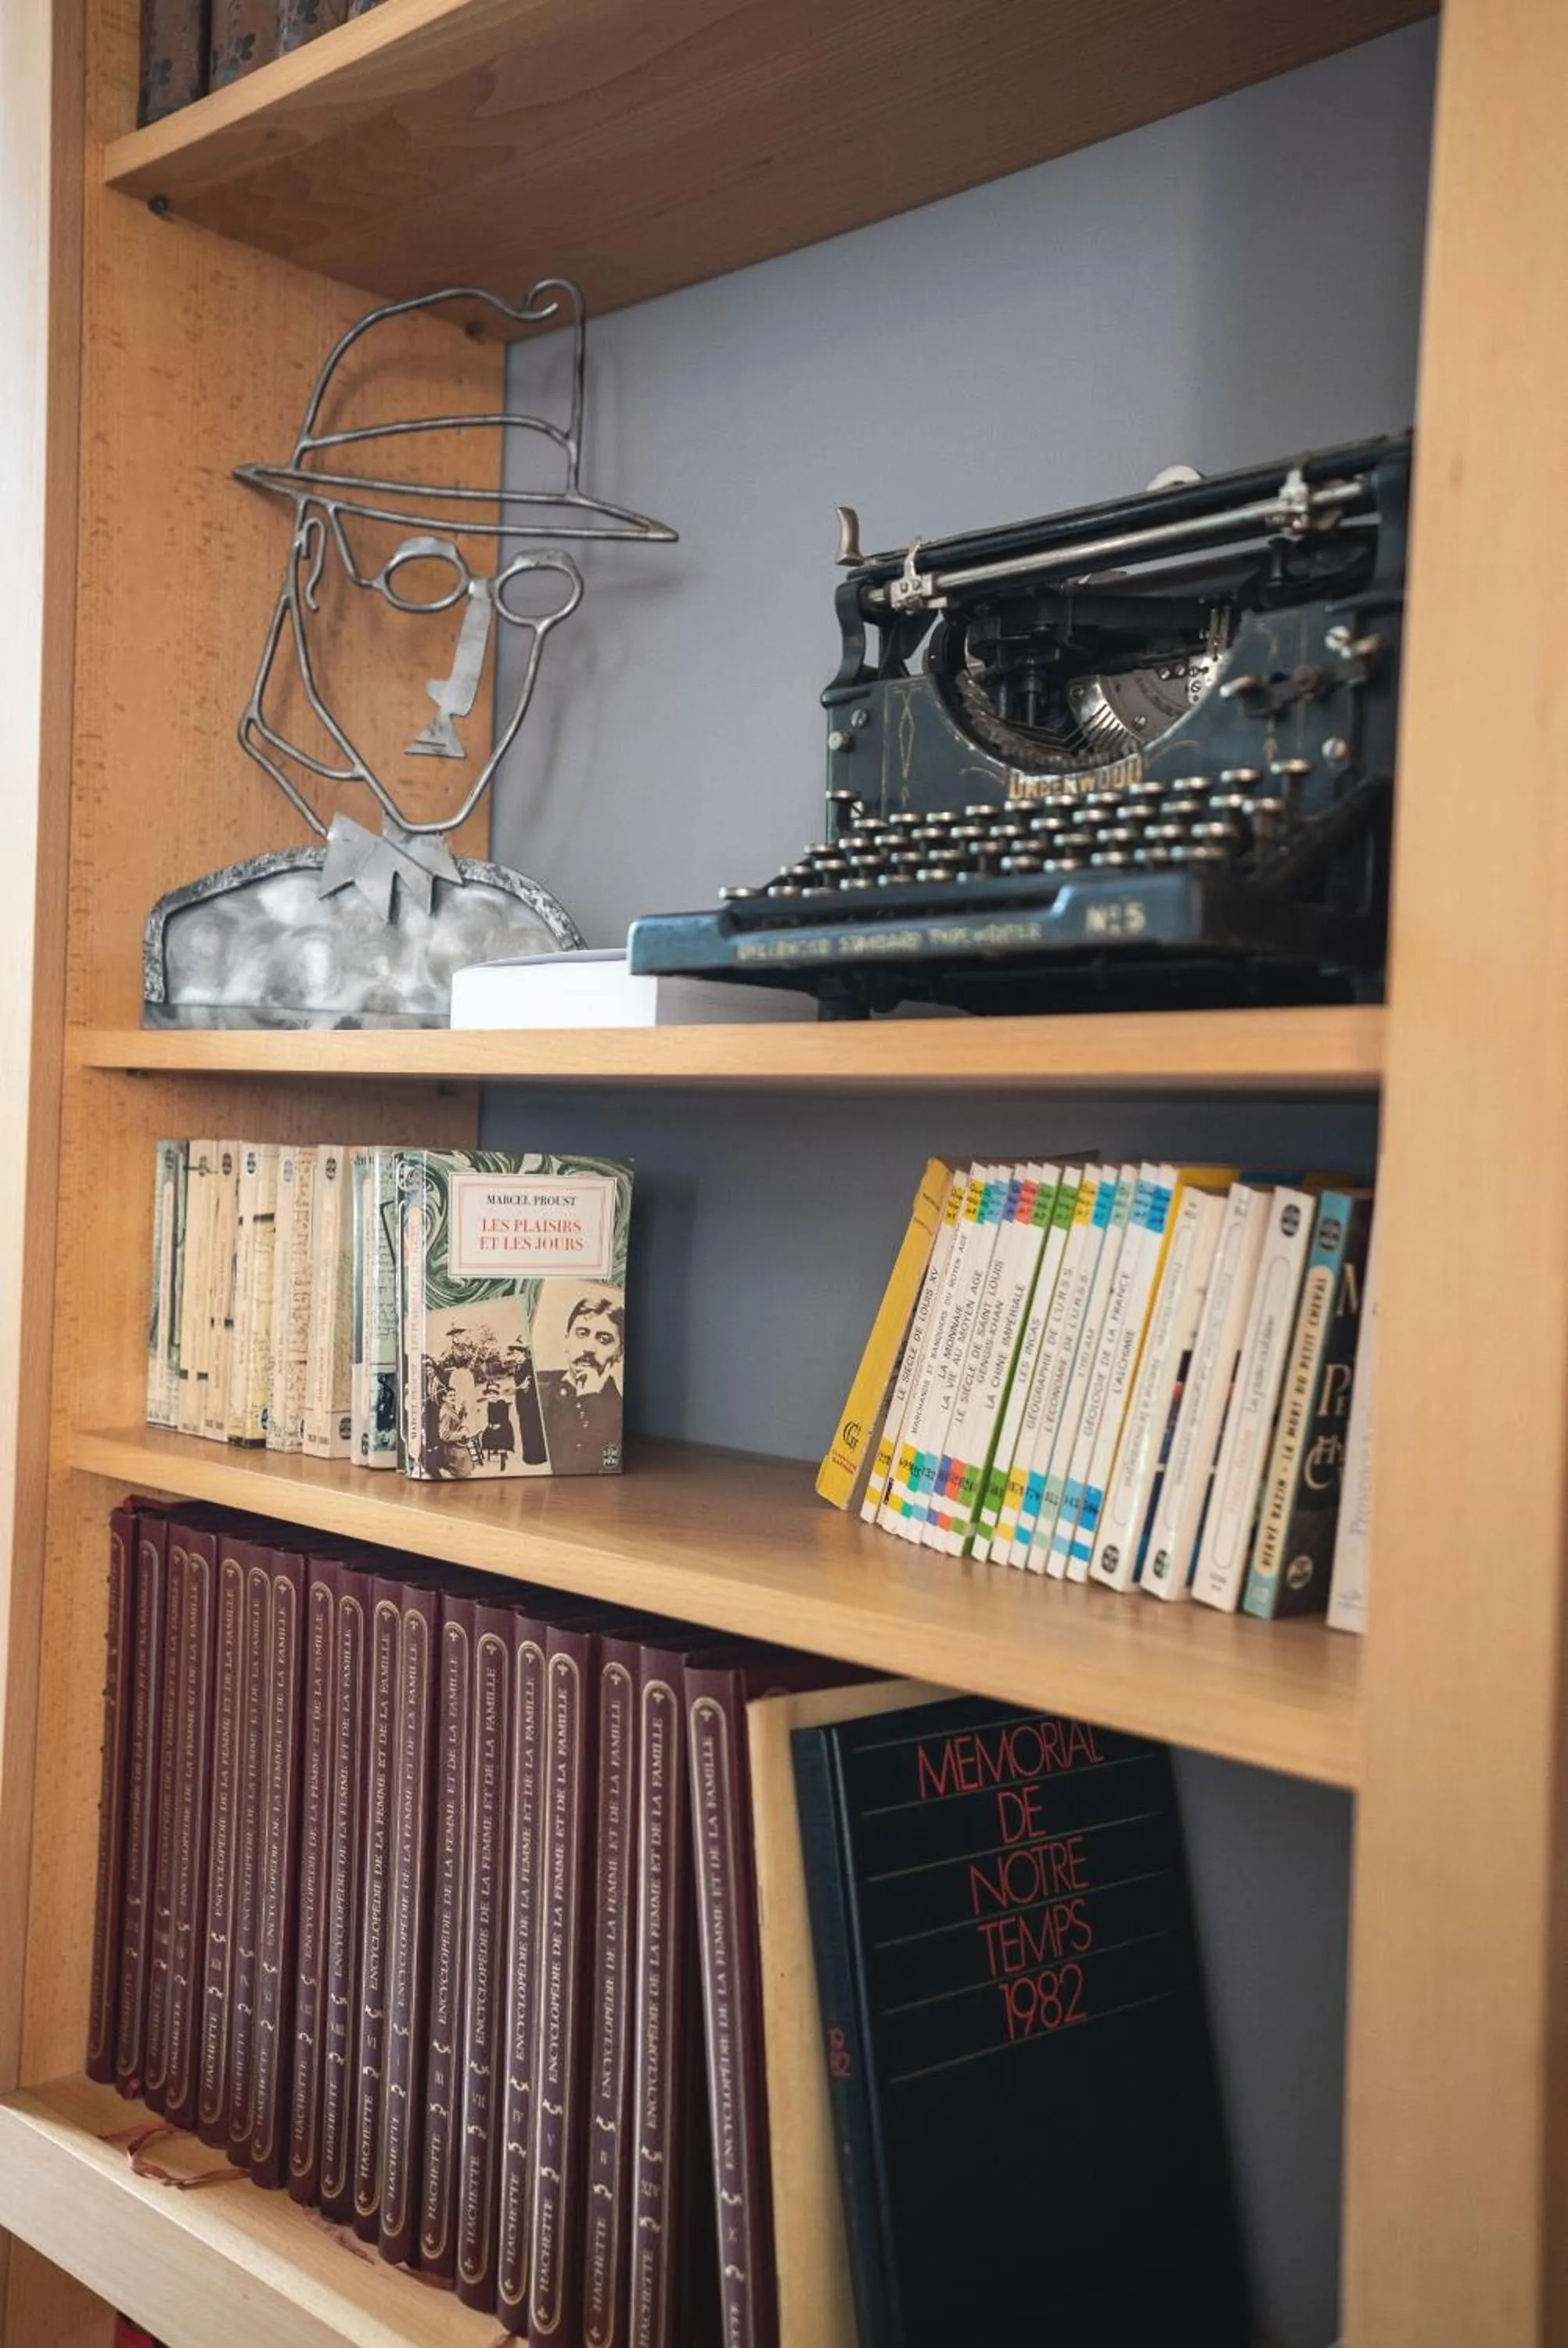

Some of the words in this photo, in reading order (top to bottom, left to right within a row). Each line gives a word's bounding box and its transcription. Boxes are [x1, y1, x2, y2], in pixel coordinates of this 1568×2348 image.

[482, 1218, 509, 1232] LES
[514, 1219, 582, 1233] PLAISIRS
[487, 1194, 530, 1205] MARCEL
[534, 1195, 577, 1206] PROUST
[480, 1235, 498, 1250] ET
[504, 1236, 532, 1250] LES
[534, 1237, 584, 1251] JOURS
[944, 1304, 962, 1359] MONNAIE
[917, 1721, 1105, 1799] MEMORIAL
[998, 1785, 1046, 1845] DE
[967, 1836, 1089, 1916] NOTRE
[976, 1899, 1092, 1977] TEMPS
[998, 1963, 1087, 2041] 1982
